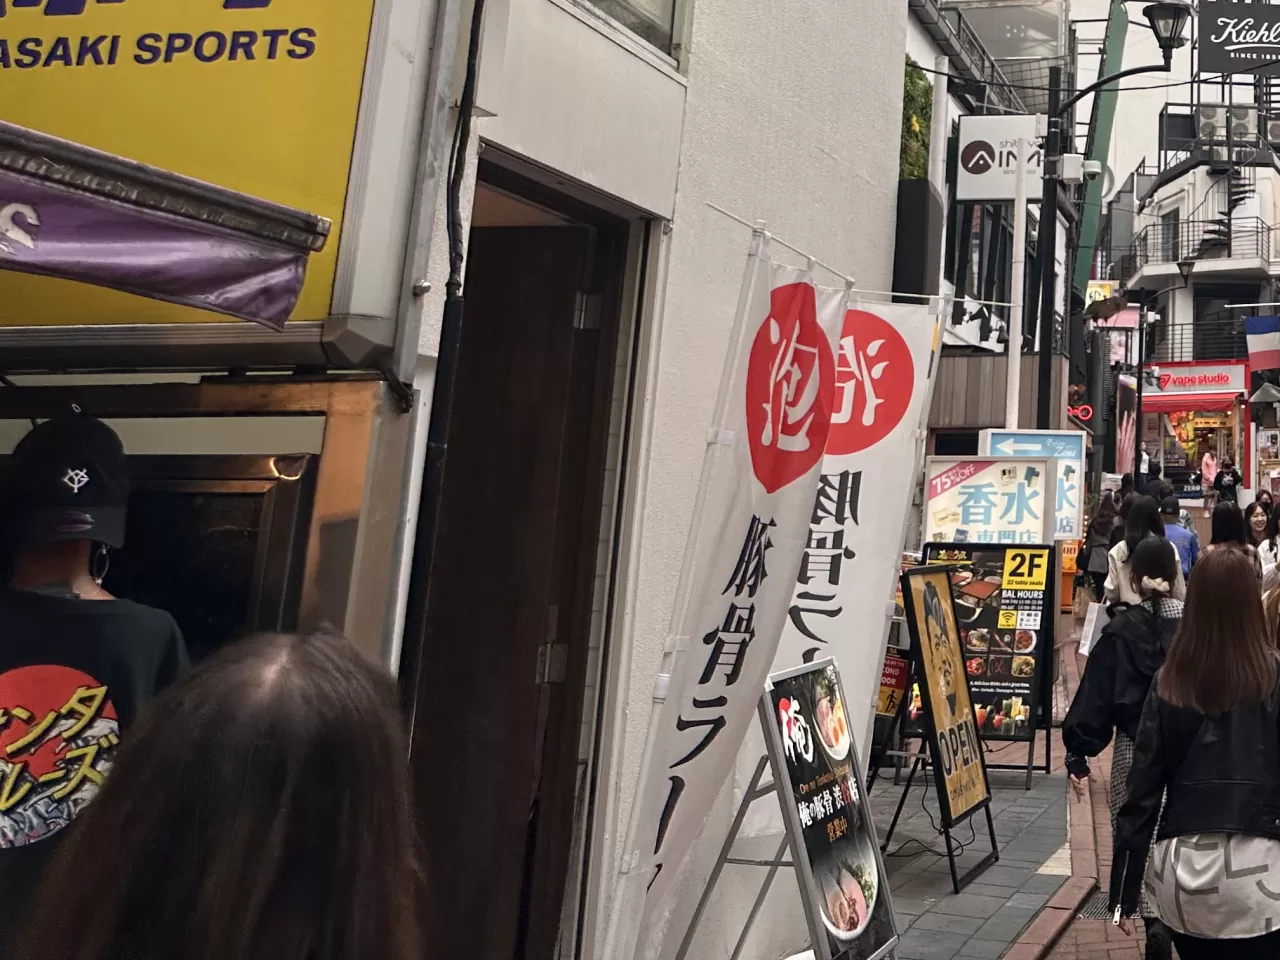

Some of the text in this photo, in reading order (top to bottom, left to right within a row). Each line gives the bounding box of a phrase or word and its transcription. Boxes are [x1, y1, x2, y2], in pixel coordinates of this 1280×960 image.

[133, 27, 317, 65] SPORTS
[1172, 373, 1230, 386] vape studio
[957, 480, 1041, 527] 香水
[1008, 553, 1044, 578] 2F
[1001, 589, 1044, 600] BAL HOURS
[939, 720, 978, 777] OPEN
[827, 815, 848, 843] 営業中
